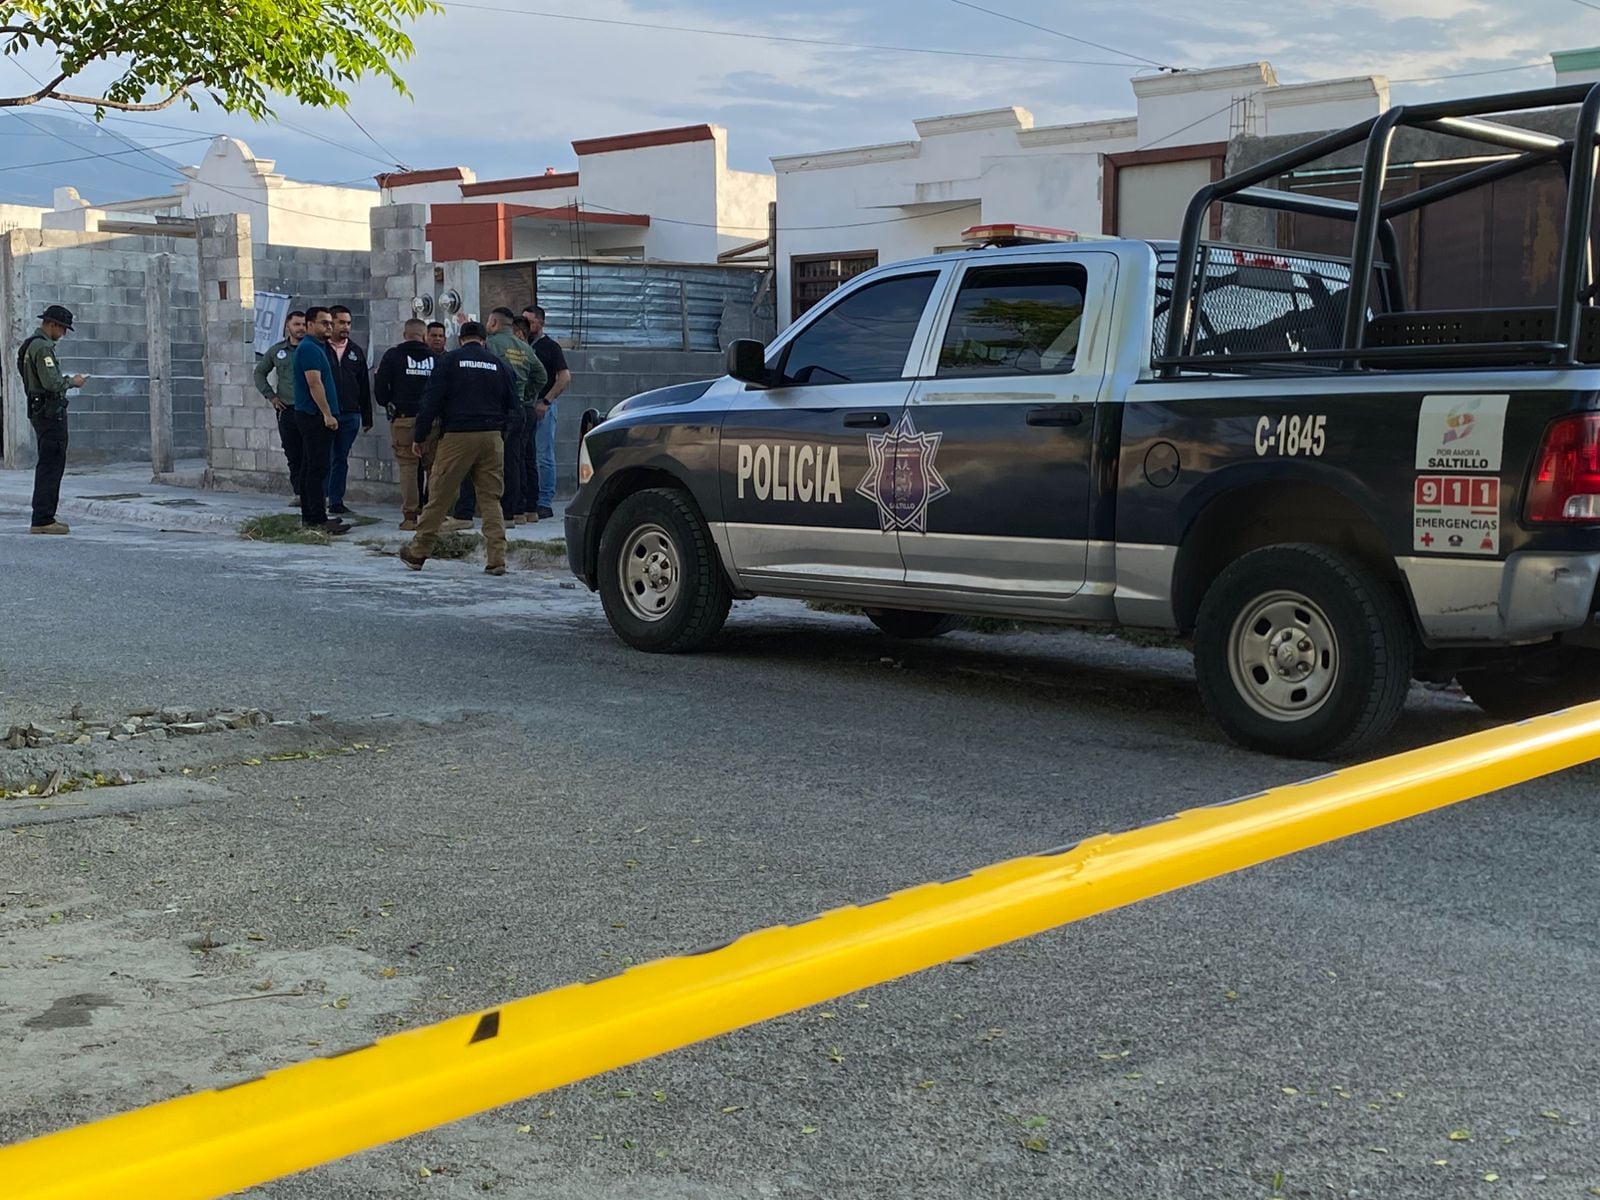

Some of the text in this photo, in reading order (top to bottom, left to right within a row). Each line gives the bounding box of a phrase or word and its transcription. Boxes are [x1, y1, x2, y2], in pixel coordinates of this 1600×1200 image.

[1254, 414, 1327, 457] C-1845
[1436, 448, 1452, 456] POR
[1428, 457, 1489, 469] SALTILLO
[1415, 517, 1497, 530] EMERGENCIAS
